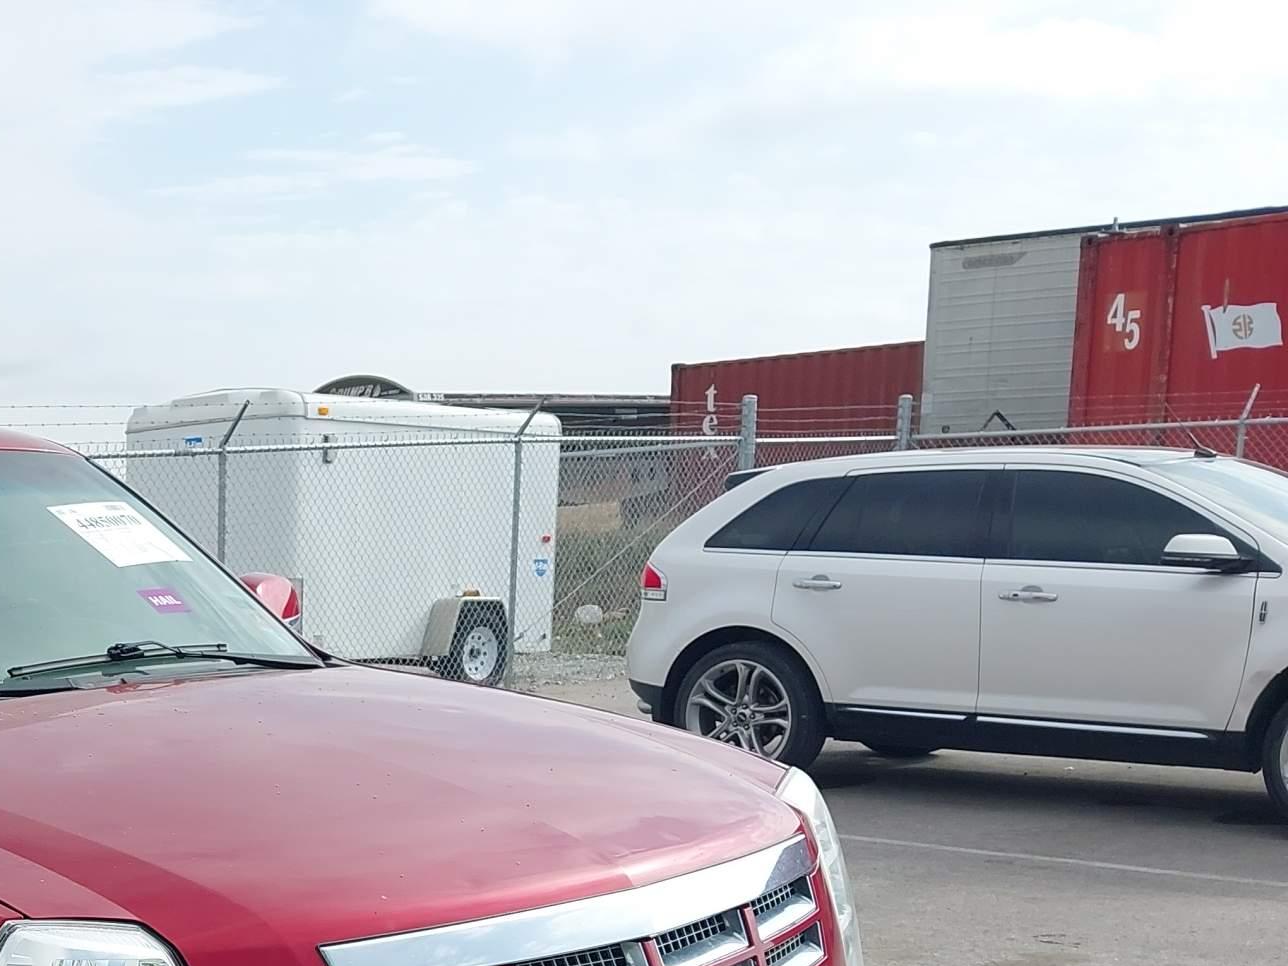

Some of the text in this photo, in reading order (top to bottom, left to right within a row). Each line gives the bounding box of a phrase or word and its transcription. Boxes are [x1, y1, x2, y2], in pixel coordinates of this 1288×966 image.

[1106, 293, 1141, 350] 45
[75, 514, 142, 529] 44850070
[147, 594, 182, 606] HAIL
